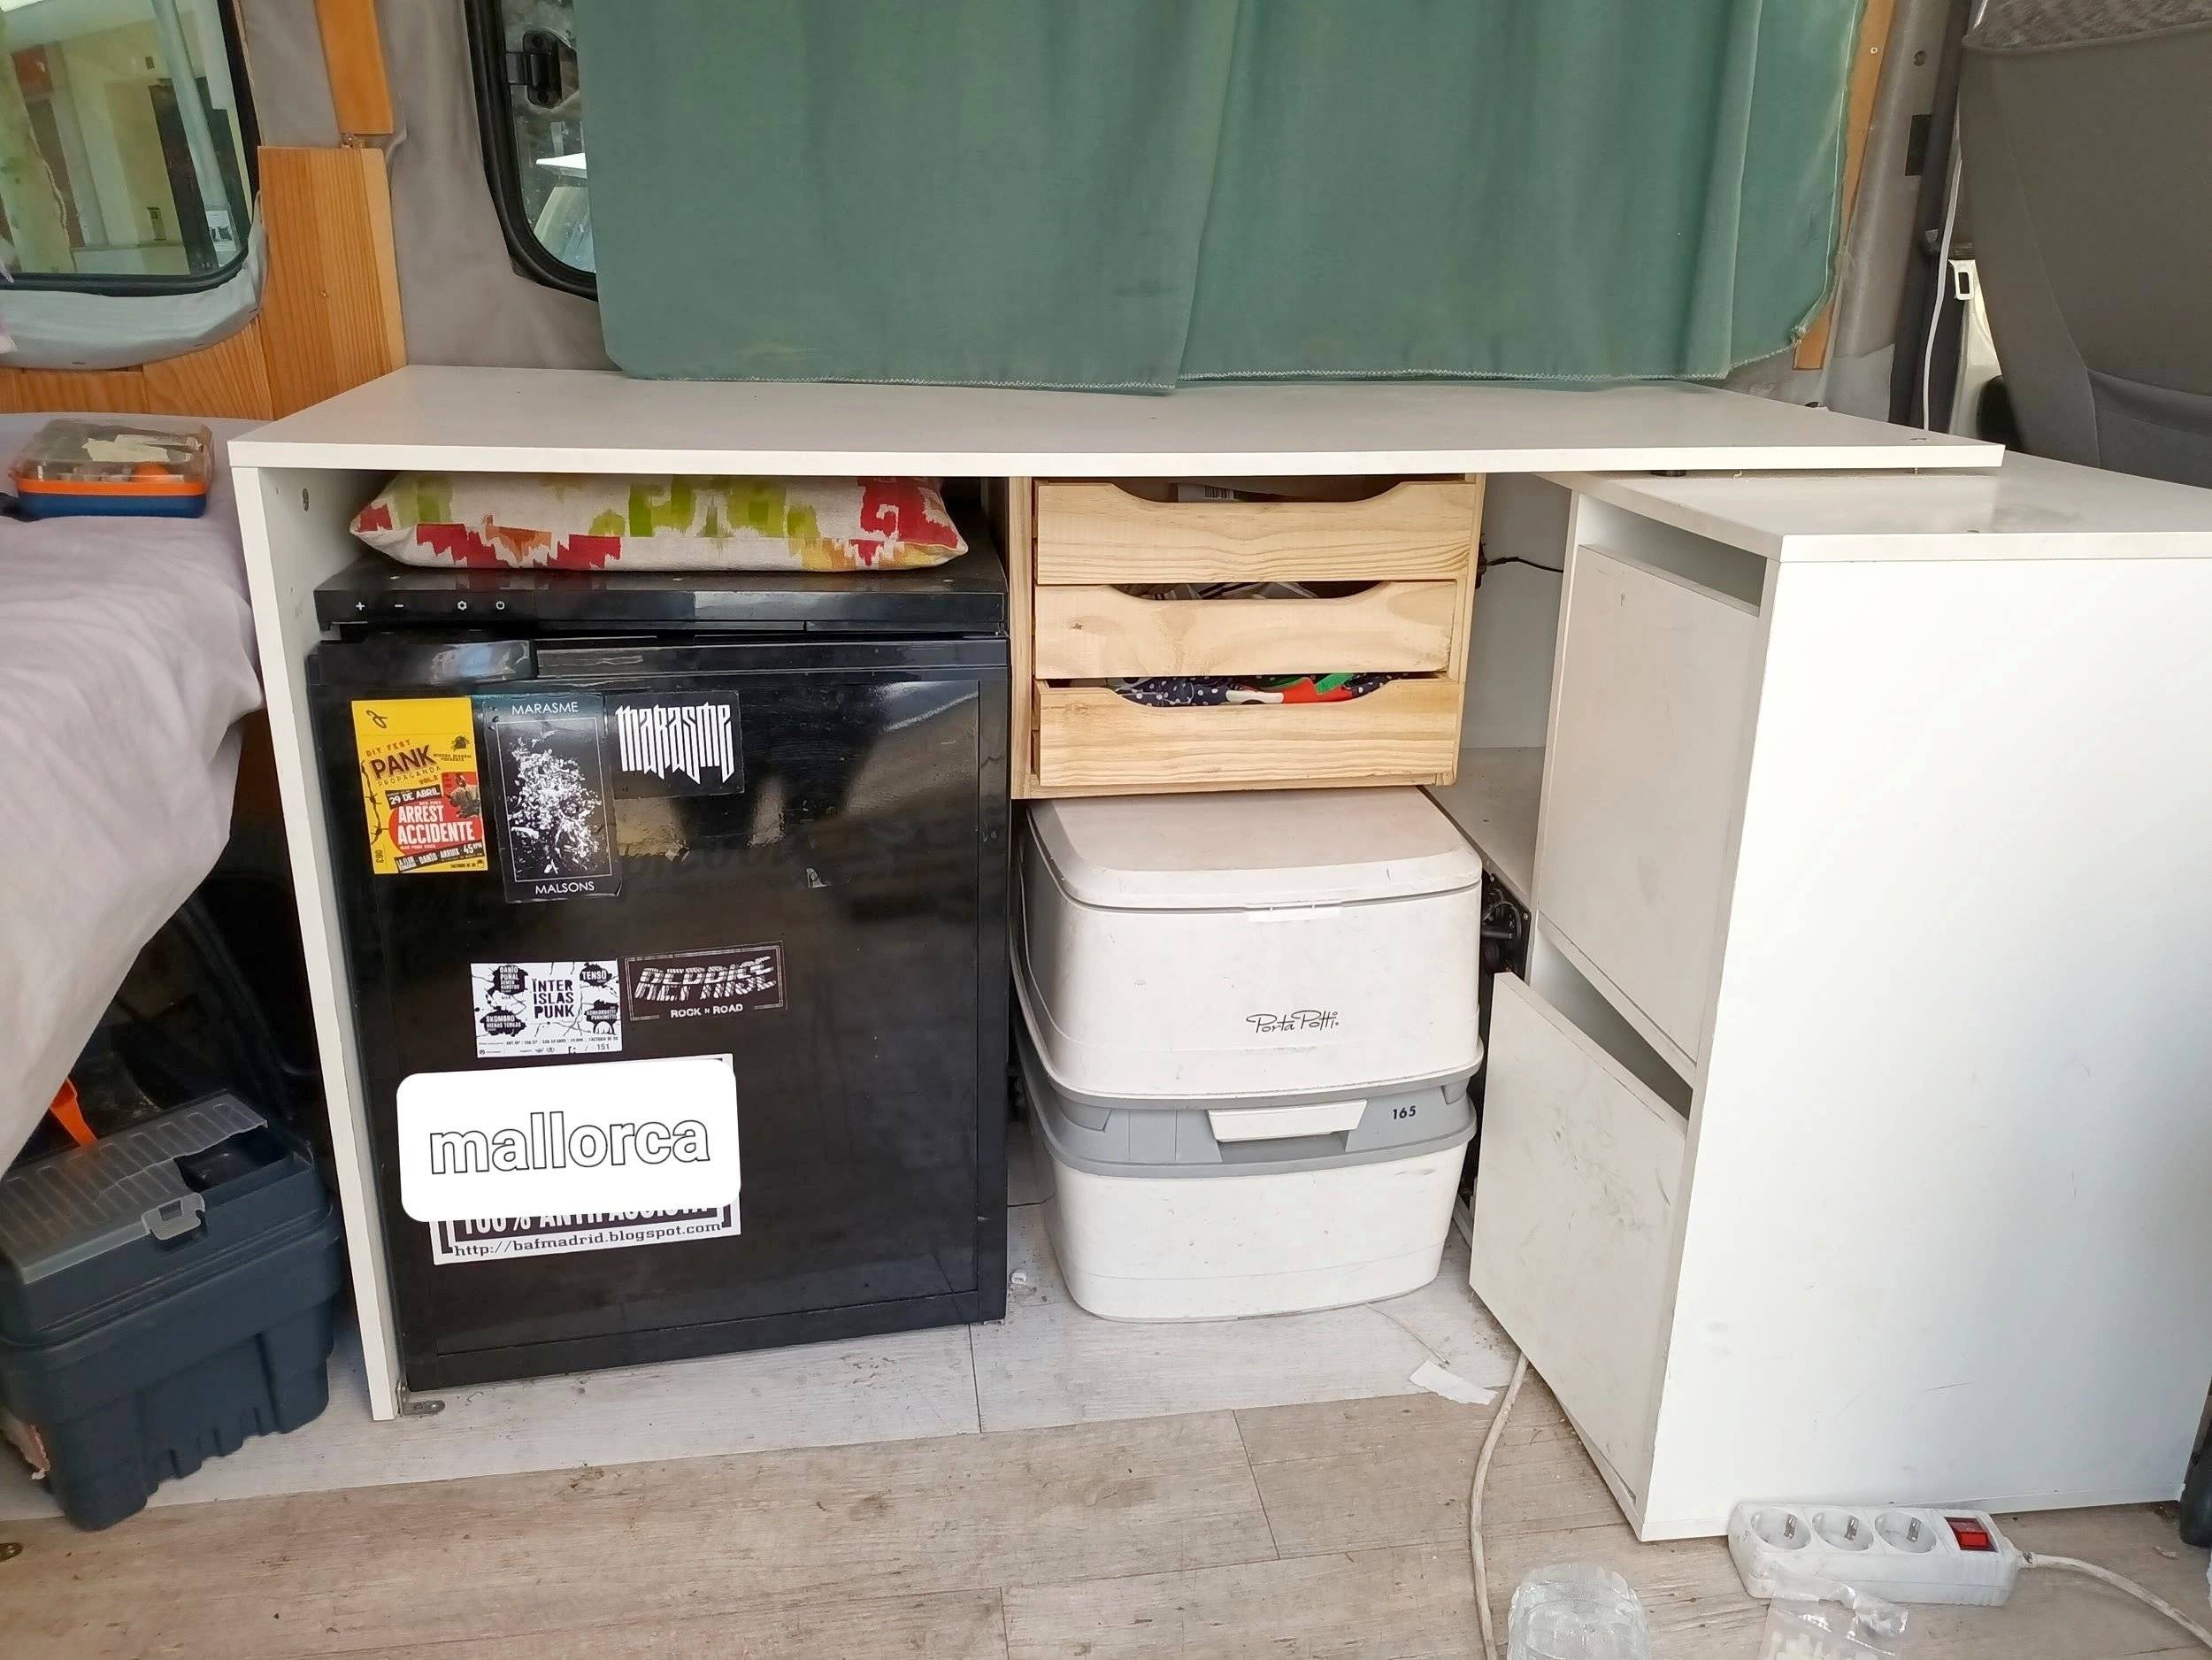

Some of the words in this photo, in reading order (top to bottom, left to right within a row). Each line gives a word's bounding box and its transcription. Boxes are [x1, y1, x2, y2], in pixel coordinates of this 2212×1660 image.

[511, 701, 579, 716] MARASME
[369, 744, 437, 780] PANK
[389, 795, 402, 805] 29
[403, 791, 416, 801] DE
[416, 787, 441, 799] ABRIL
[398, 804, 444, 824] ARREST
[397, 821, 476, 846] ACCIDENTE
[535, 880, 595, 895] MALSONS
[534, 992, 574, 1005] ISLAS
[534, 1004, 575, 1019] PUNK
[671, 1007, 702, 1018] ROCK
[712, 1003, 744, 1015] ROAD
[1246, 1013, 1295, 1034] Porta
[1393, 1105, 1417, 1120] 165
[454, 1223, 722, 1257] http://bafmadrid.blogspot.com
